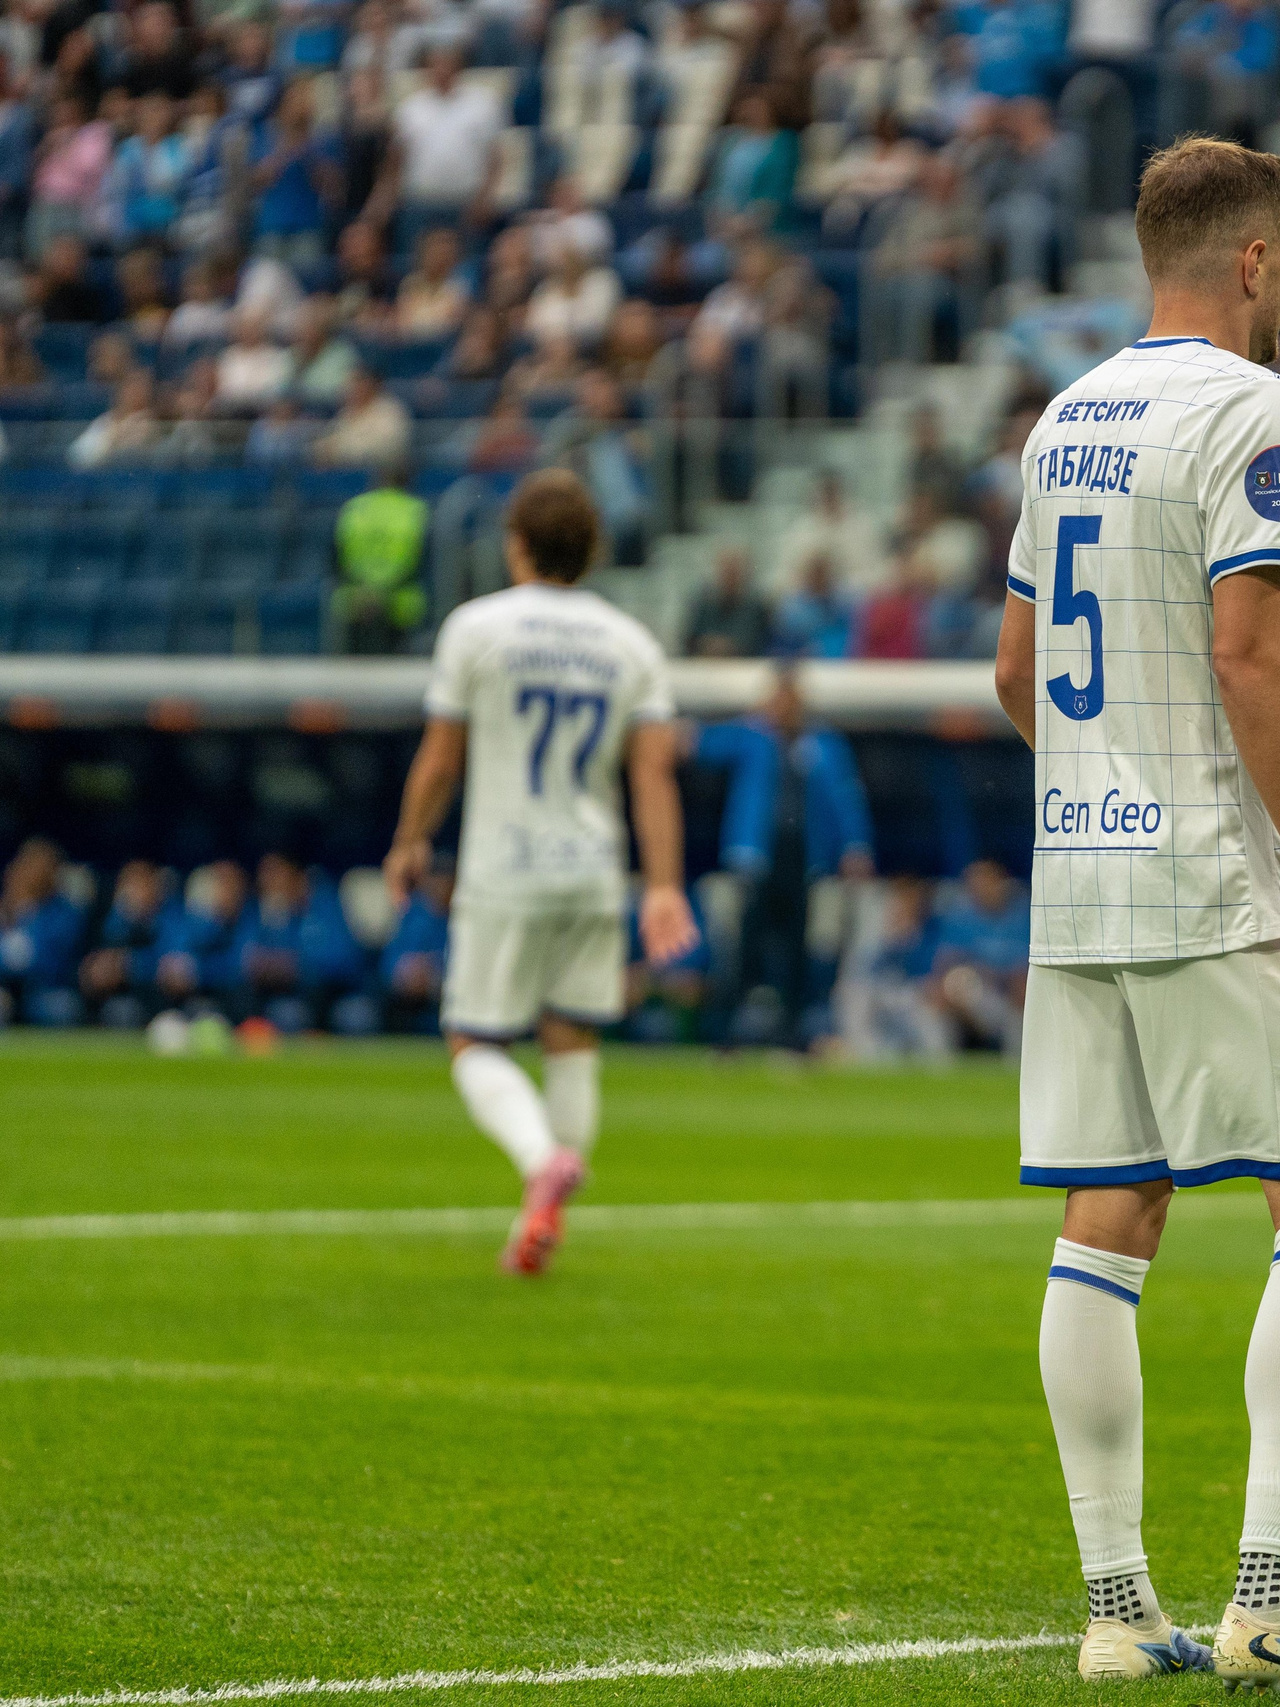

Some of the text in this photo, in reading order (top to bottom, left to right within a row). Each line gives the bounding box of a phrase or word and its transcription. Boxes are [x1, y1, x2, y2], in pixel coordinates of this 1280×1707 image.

[1056, 400, 1150, 424] БЕТСИТИ
[1037, 444, 1138, 495] ТАБИДЗЕ
[1046, 515, 1104, 720] 5
[516, 687, 605, 795] 77
[1043, 787, 1161, 834] Cen Geo
